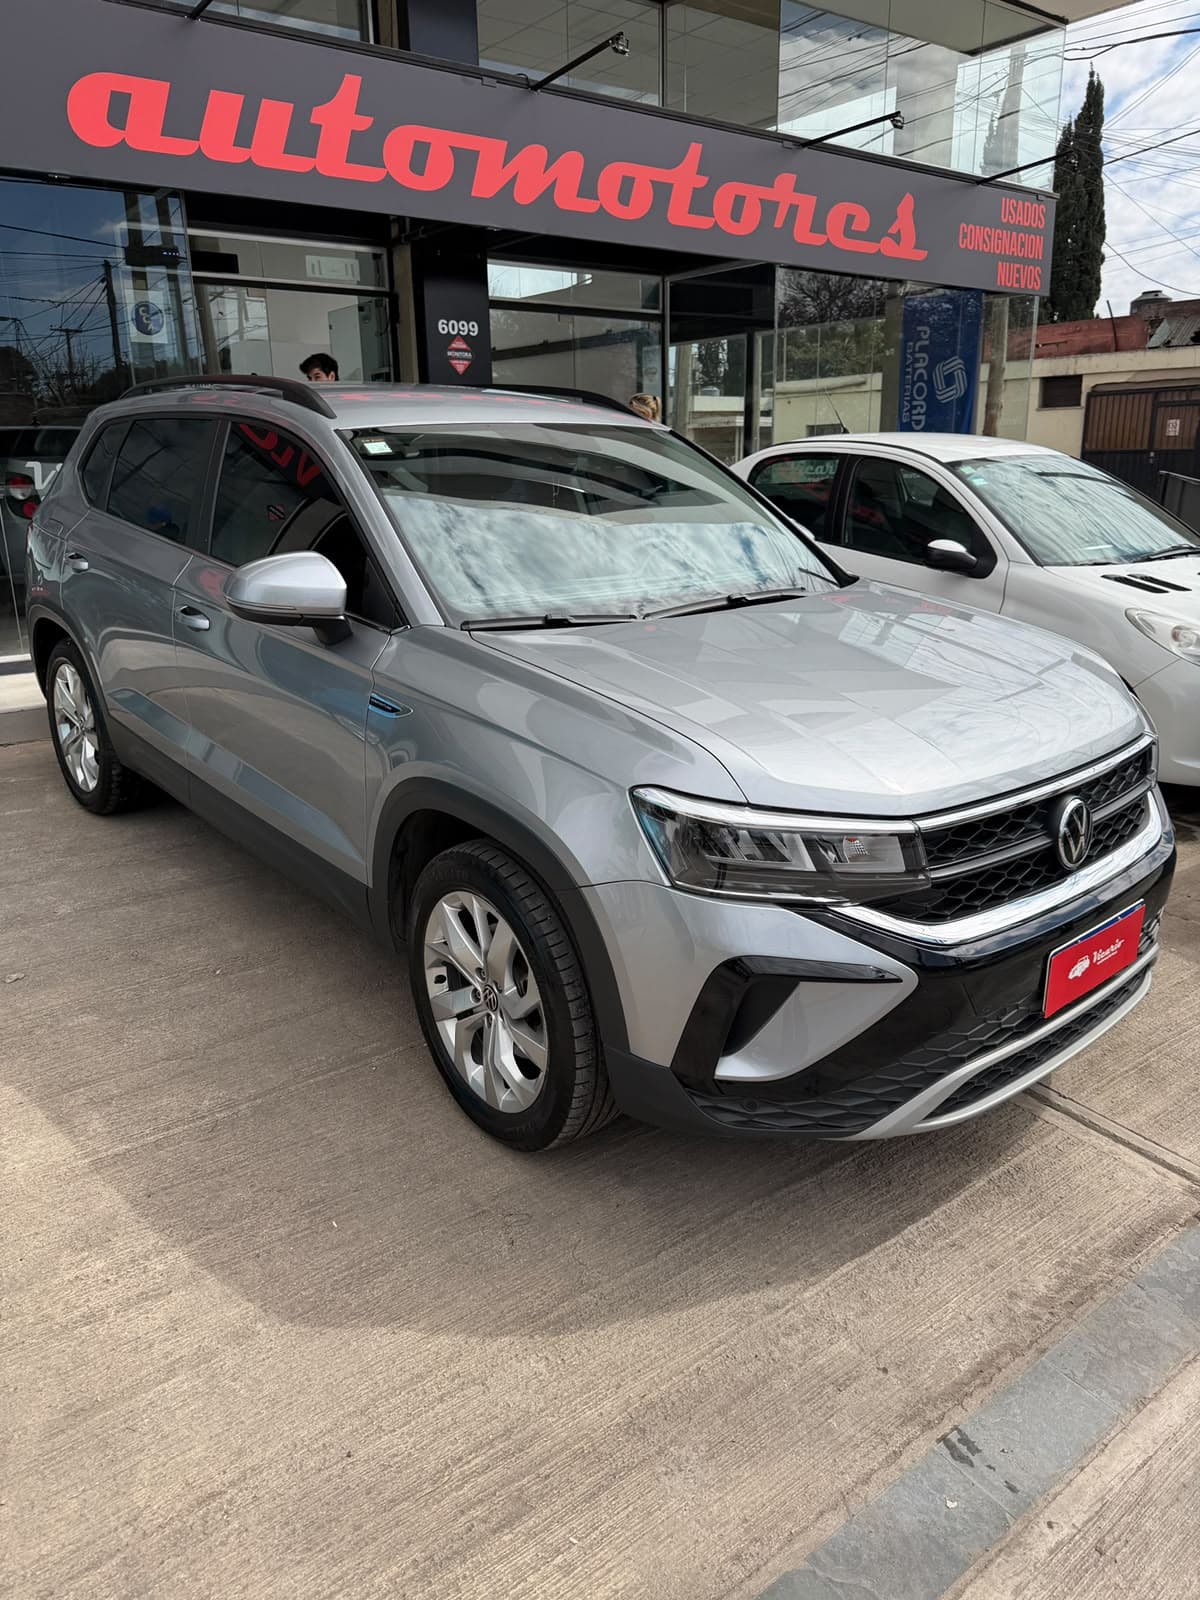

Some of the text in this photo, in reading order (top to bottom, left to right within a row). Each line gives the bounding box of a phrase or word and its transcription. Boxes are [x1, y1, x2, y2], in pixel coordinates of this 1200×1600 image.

[66, 72, 928, 261] automotores
[1000, 197, 1047, 229] USADOS
[958, 222, 1044, 261] CONSIGNACION
[996, 261, 1042, 291] NUEVOS
[438, 319, 479, 337] 6099
[902, 342, 914, 424] BATERIAS
[911, 325, 930, 431] PLACORD
